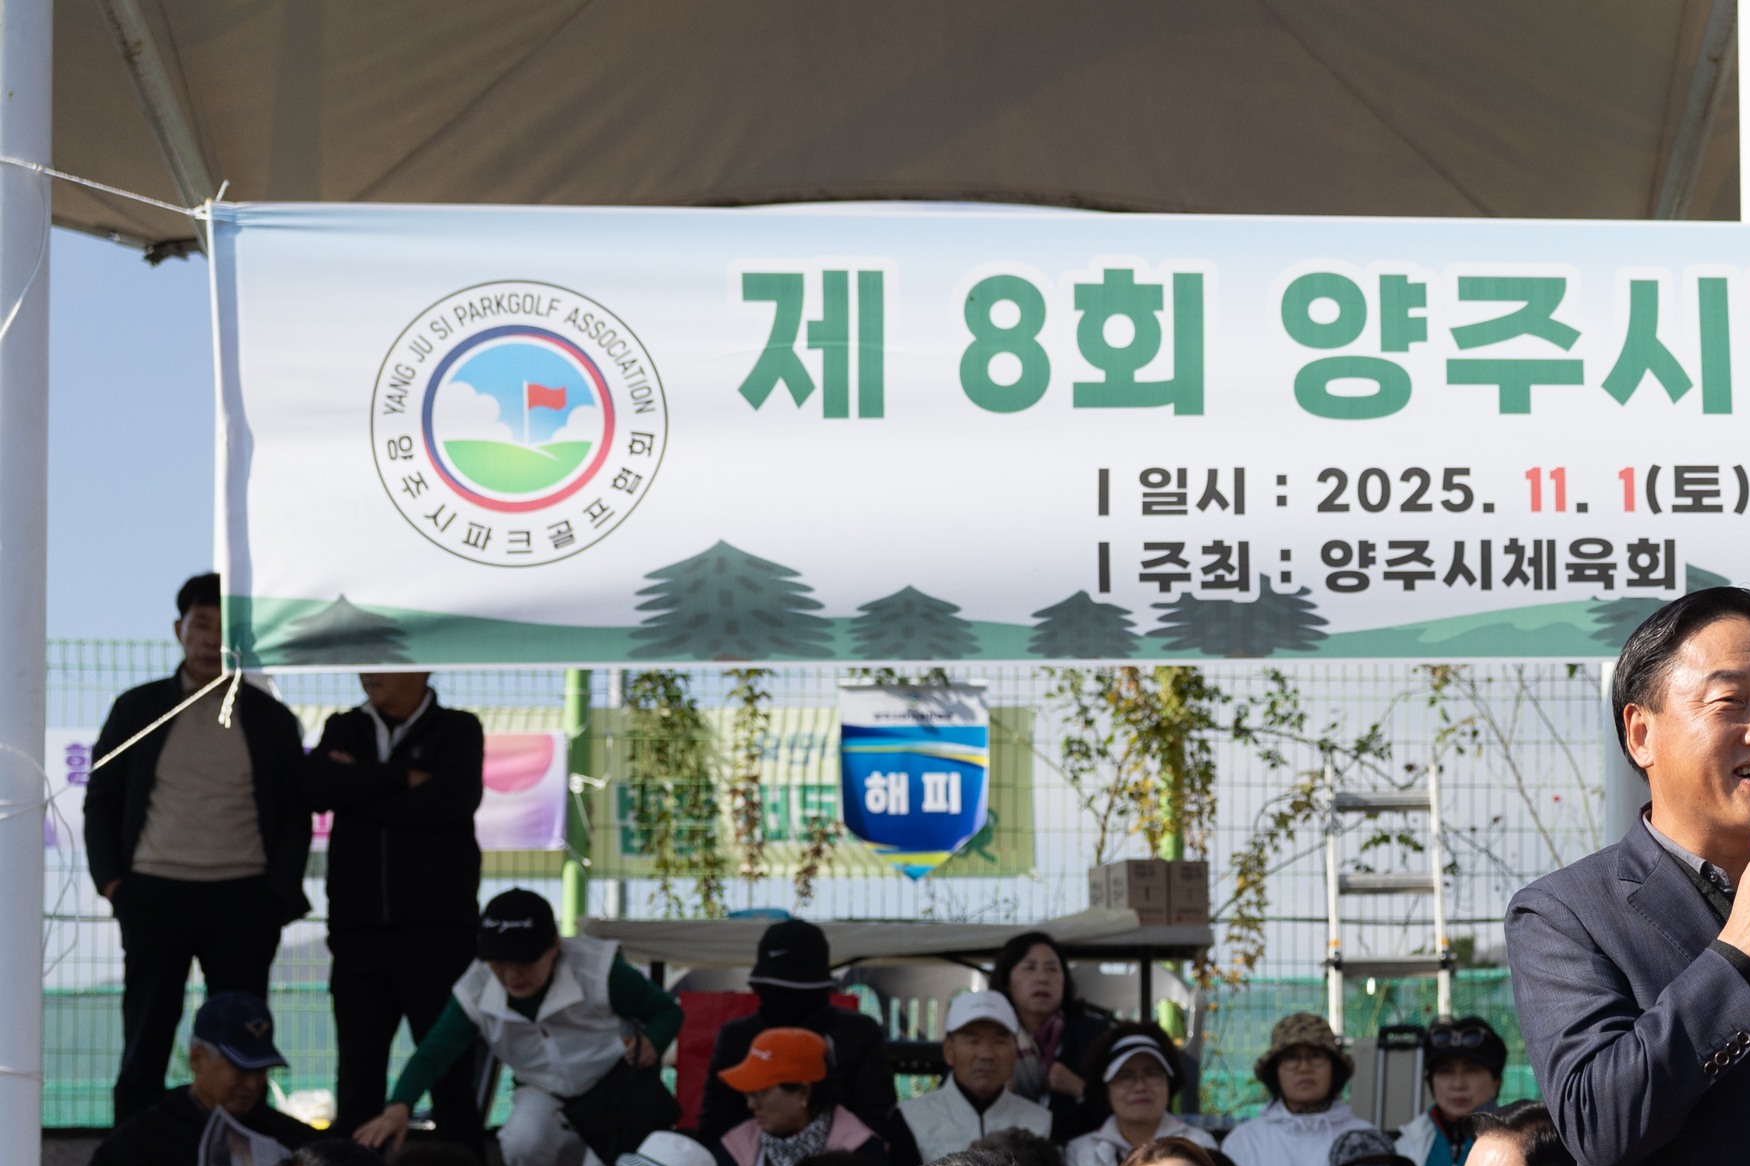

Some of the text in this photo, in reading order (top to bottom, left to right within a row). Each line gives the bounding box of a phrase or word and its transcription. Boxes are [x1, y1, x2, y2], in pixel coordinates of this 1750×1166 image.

[383, 292, 656, 415] YANG JU SI PARKGOLF ASSOCIATION
[739, 270, 885, 418] 제
[959, 269, 1204, 416] 8회
[387, 430, 655, 554] 양주시파크골프협회
[1139, 467, 1246, 516] 일시
[1316, 466, 1496, 514] 2025.
[1525, 466, 1590, 513] 11.
[1618, 464, 1750, 515] 1(토)
[1138, 539, 1251, 592] 주최
[1319, 537, 1677, 592] 양주시체육회
